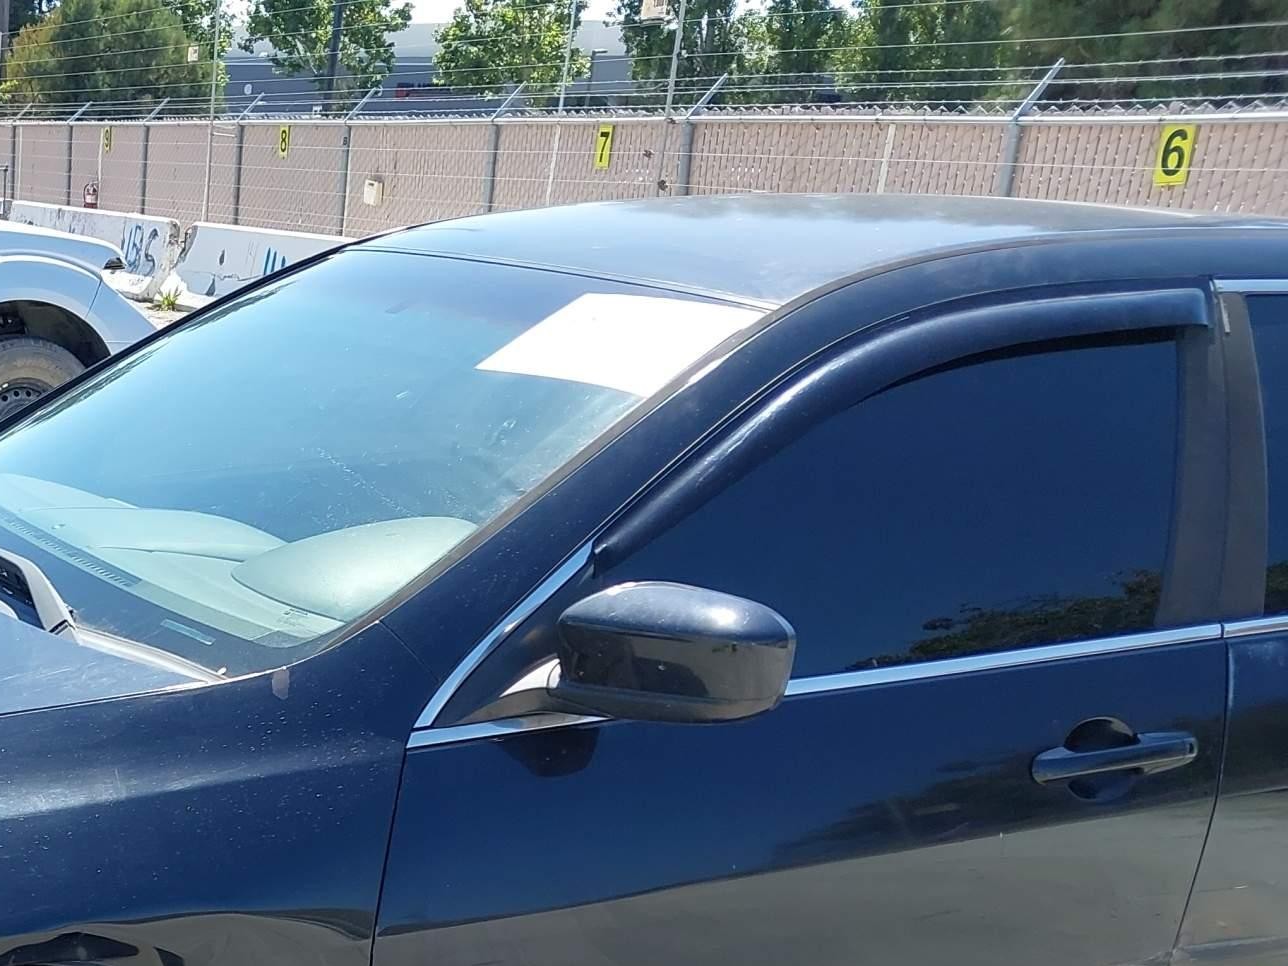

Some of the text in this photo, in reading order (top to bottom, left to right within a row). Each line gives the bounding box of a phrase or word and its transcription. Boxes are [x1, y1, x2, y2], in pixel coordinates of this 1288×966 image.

[280, 129, 288, 153] 8
[599, 131, 611, 163] 7
[1160, 128, 1189, 177] 6
